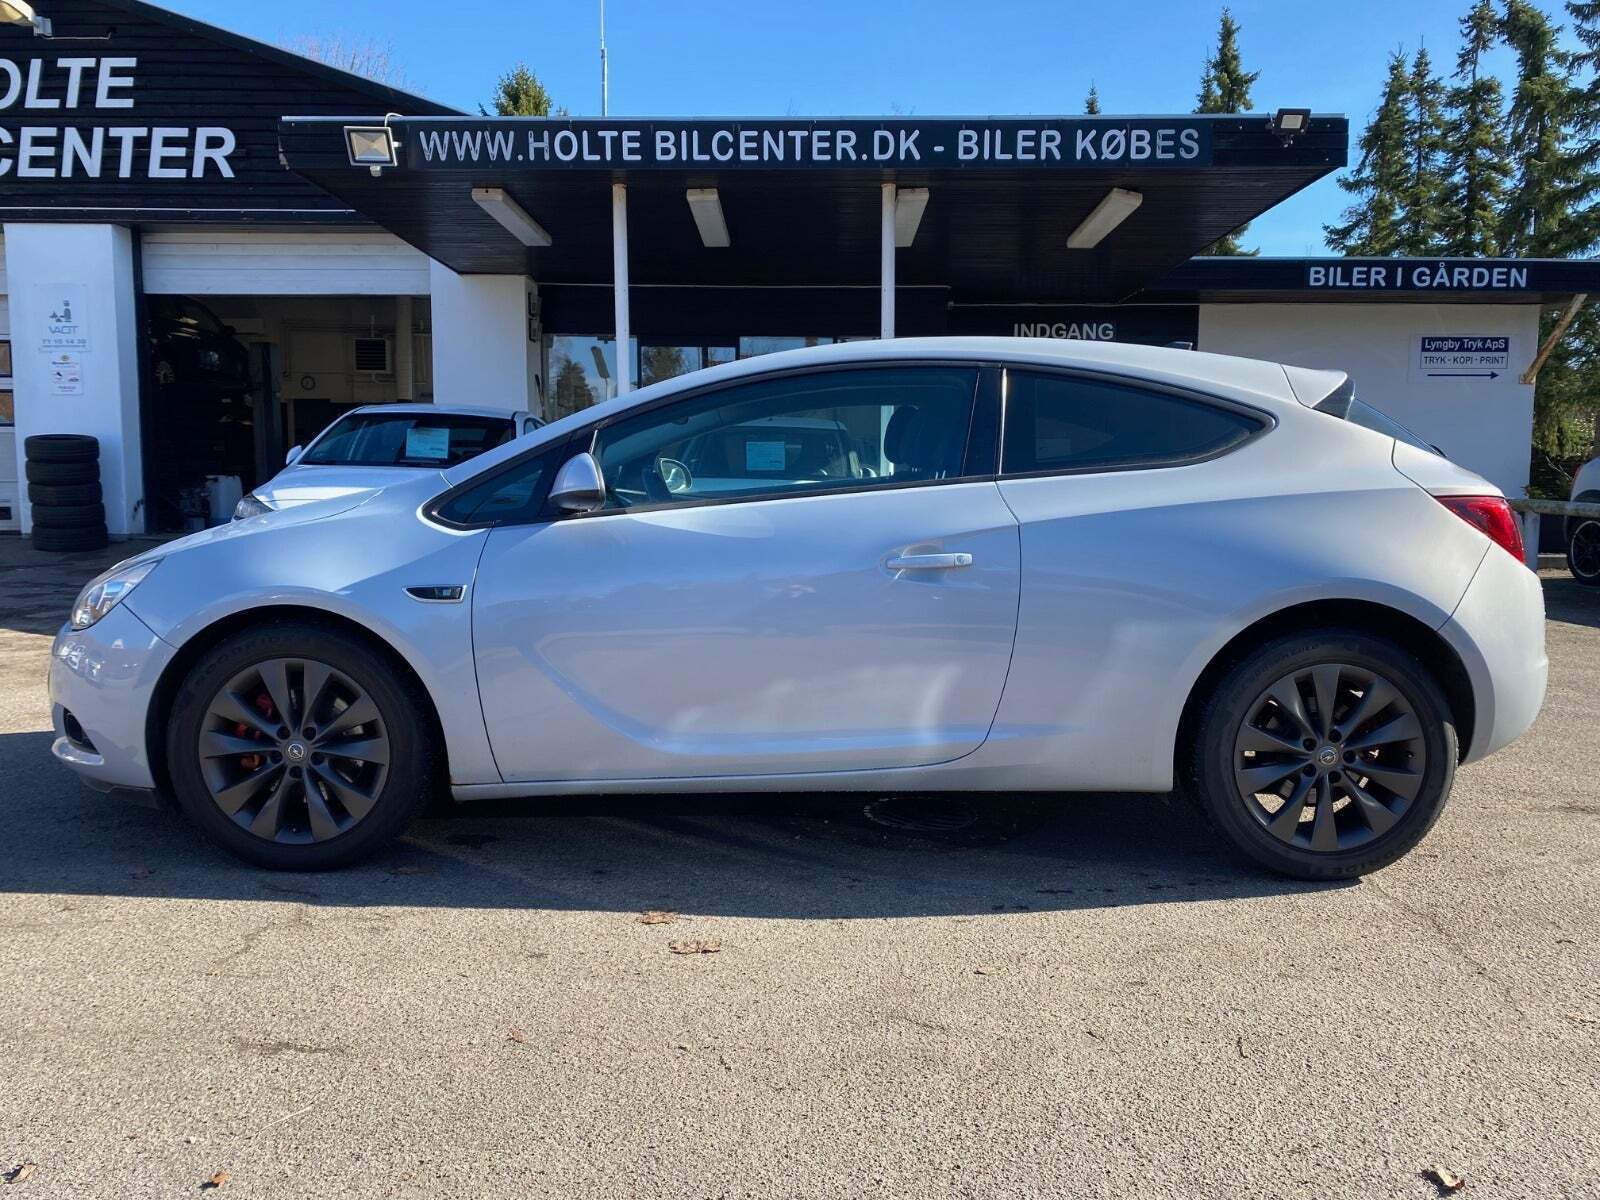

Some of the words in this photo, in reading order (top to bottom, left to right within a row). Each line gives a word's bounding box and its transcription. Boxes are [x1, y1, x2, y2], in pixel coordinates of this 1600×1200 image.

[0, 126, 236, 179] ENTER
[655, 129, 921, 161] BILCENTER.DK
[957, 129, 1062, 161] BILER
[1075, 128, 1200, 161] KØBES
[1309, 266, 1386, 287] BILER
[1396, 267, 1402, 287] I
[1412, 262, 1528, 288] GÅRDEN
[1013, 322, 1114, 340] INDGANG
[1424, 339, 1461, 350] Lyngby
[1463, 339, 1484, 350] Tryk
[1485, 339, 1506, 350] ApS
[1423, 356, 1446, 364] TRYK
[1453, 356, 1473, 364] KOPI
[1480, 356, 1505, 364] PRINT
